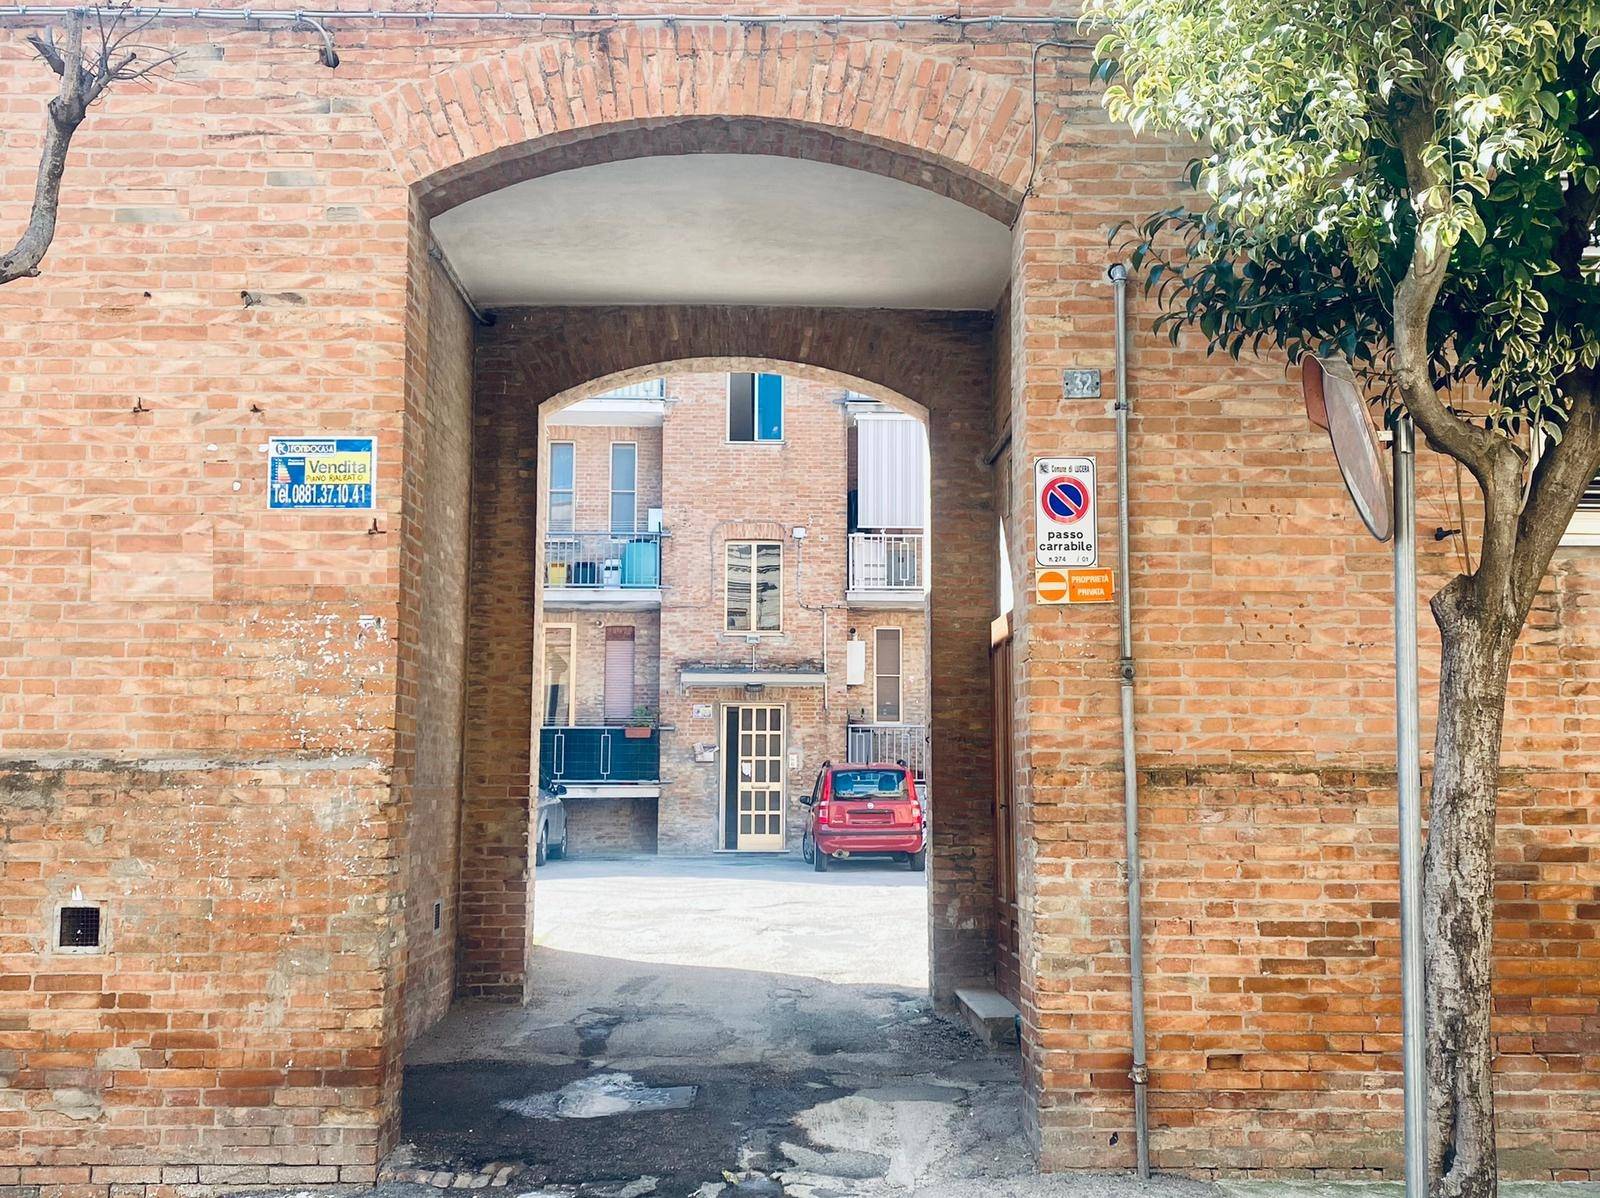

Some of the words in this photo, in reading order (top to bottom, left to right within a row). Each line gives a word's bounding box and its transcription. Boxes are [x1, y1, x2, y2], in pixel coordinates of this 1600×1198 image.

[308, 460, 367, 474] Vendita
[1051, 465, 1067, 473] Comune
[1047, 531, 1084, 541] passo
[1039, 542, 1093, 551] carrabile
[1077, 587, 1105, 596] PRIVATA
